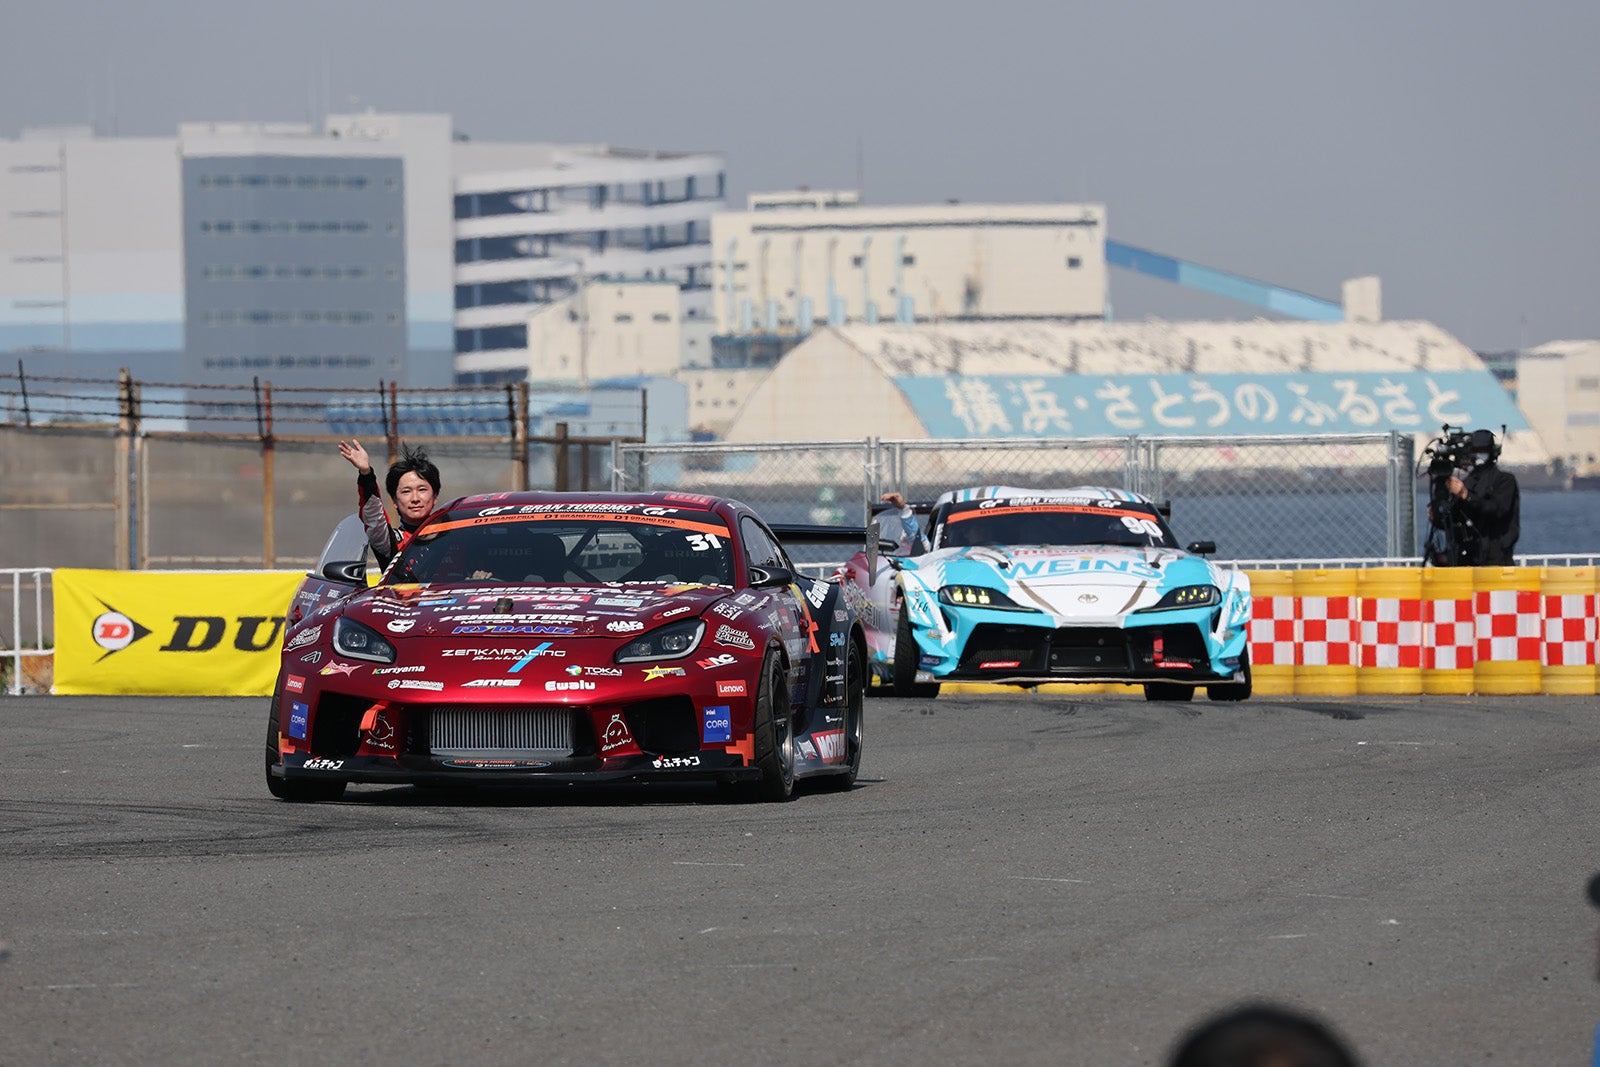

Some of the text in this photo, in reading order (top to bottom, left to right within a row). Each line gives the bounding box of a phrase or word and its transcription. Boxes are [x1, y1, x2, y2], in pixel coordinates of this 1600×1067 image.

[943, 376, 1472, 434] 横浜・さとうのふるさと
[520, 503, 633, 512] GRAN TURISMO
[1120, 515, 1163, 540] 90
[685, 533, 723, 552] 31
[371, 608, 421, 617] BRIDE
[663, 606, 691, 617] CUSCO
[99, 622, 130, 639] D
[451, 625, 579, 634] RYDANZ
[584, 666, 623, 674] TOKAI
[719, 684, 744, 693] Lenovo
